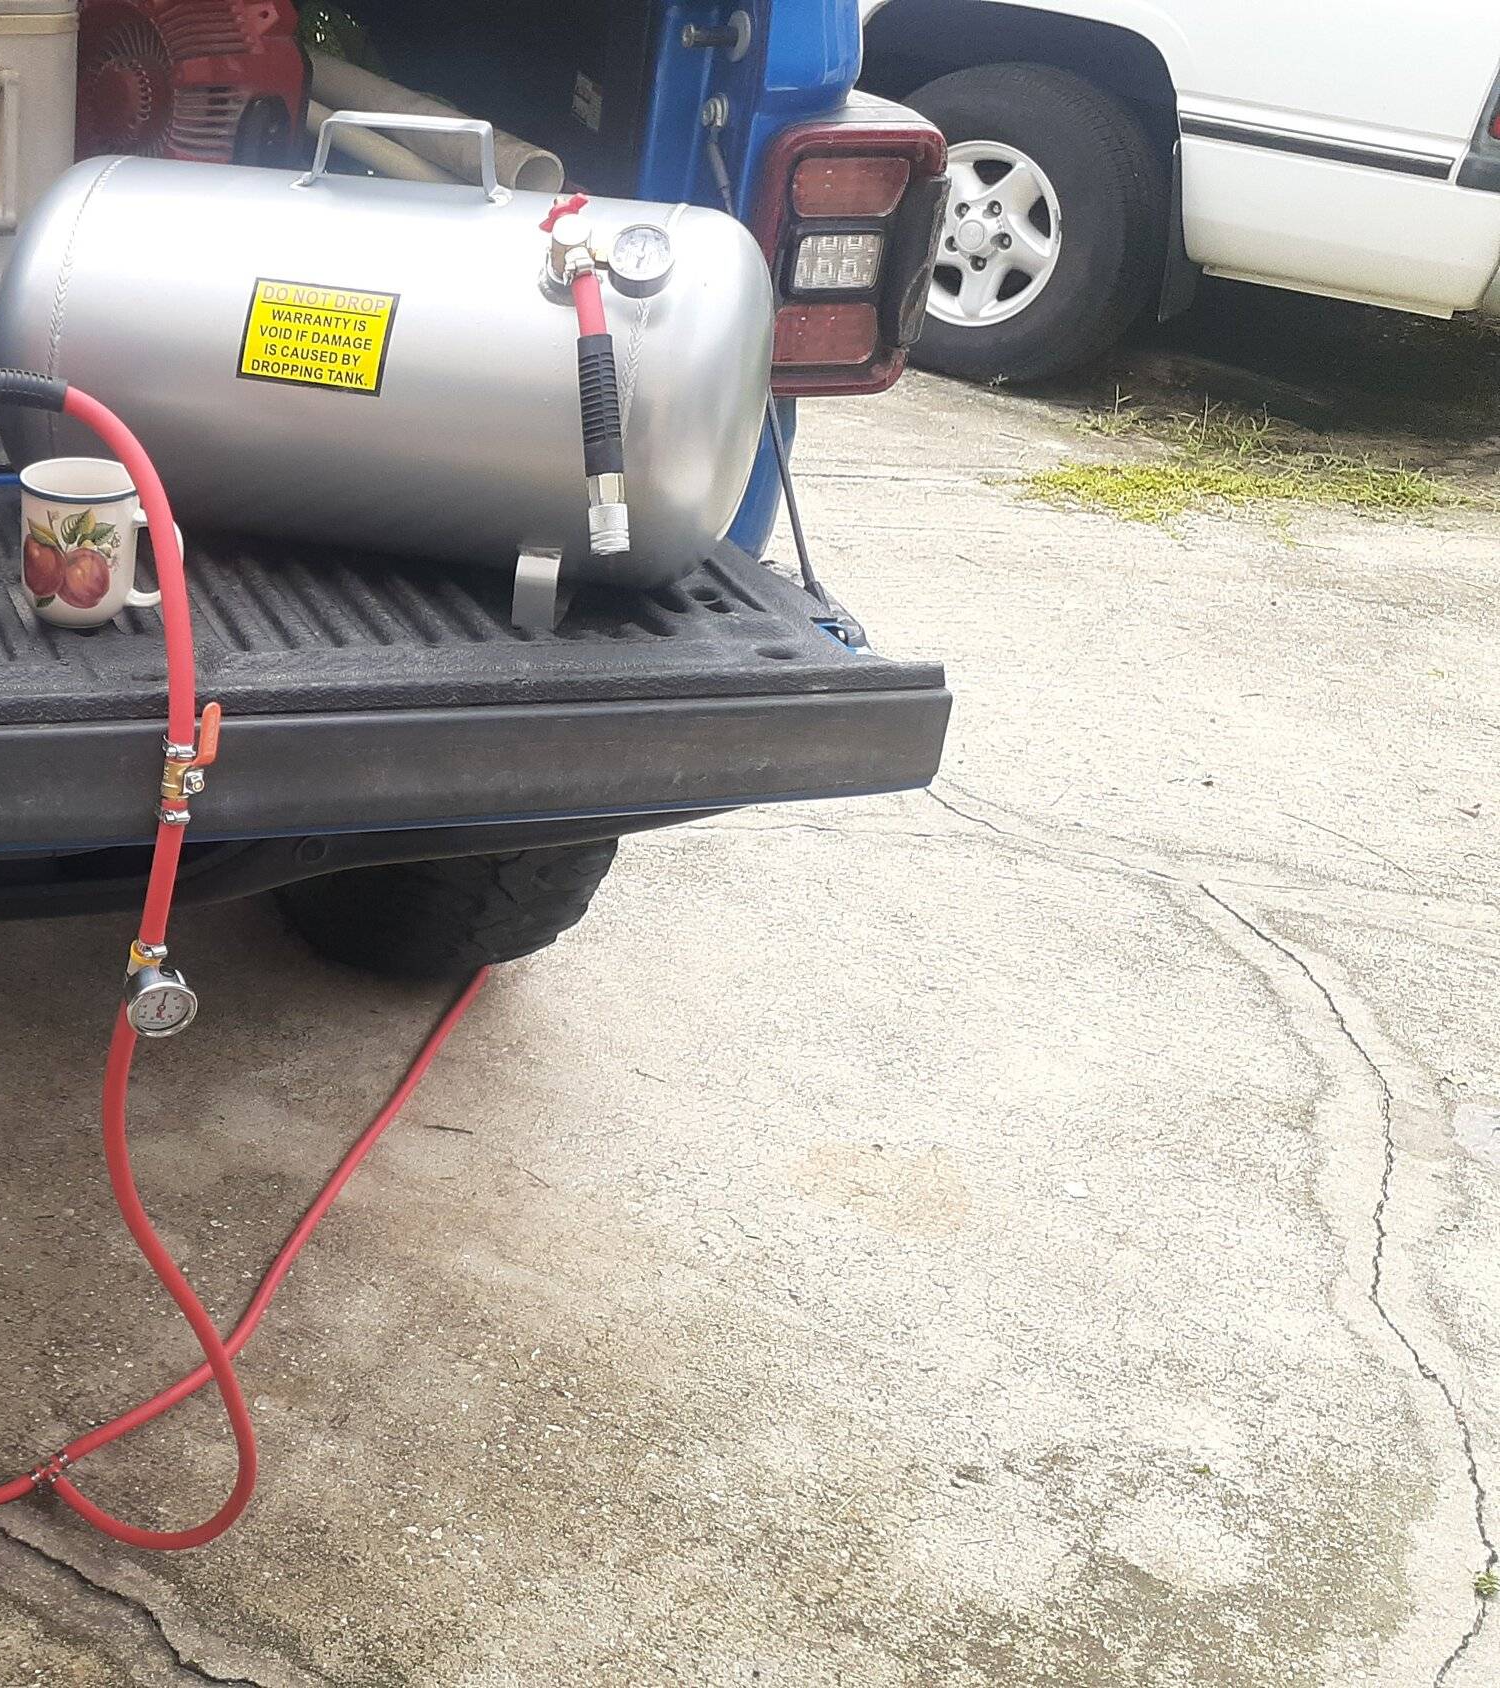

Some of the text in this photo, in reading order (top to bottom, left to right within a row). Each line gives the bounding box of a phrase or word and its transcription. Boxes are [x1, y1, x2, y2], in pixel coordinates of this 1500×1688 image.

[263, 285, 386, 313] DO NOT DROP
[272, 309, 367, 332] WARRANTY IS
[260, 325, 373, 351] VOID IF DAMAGE
[264, 343, 361, 367] IS CAUSED BY
[251, 359, 368, 386] DROPPING TANK.
